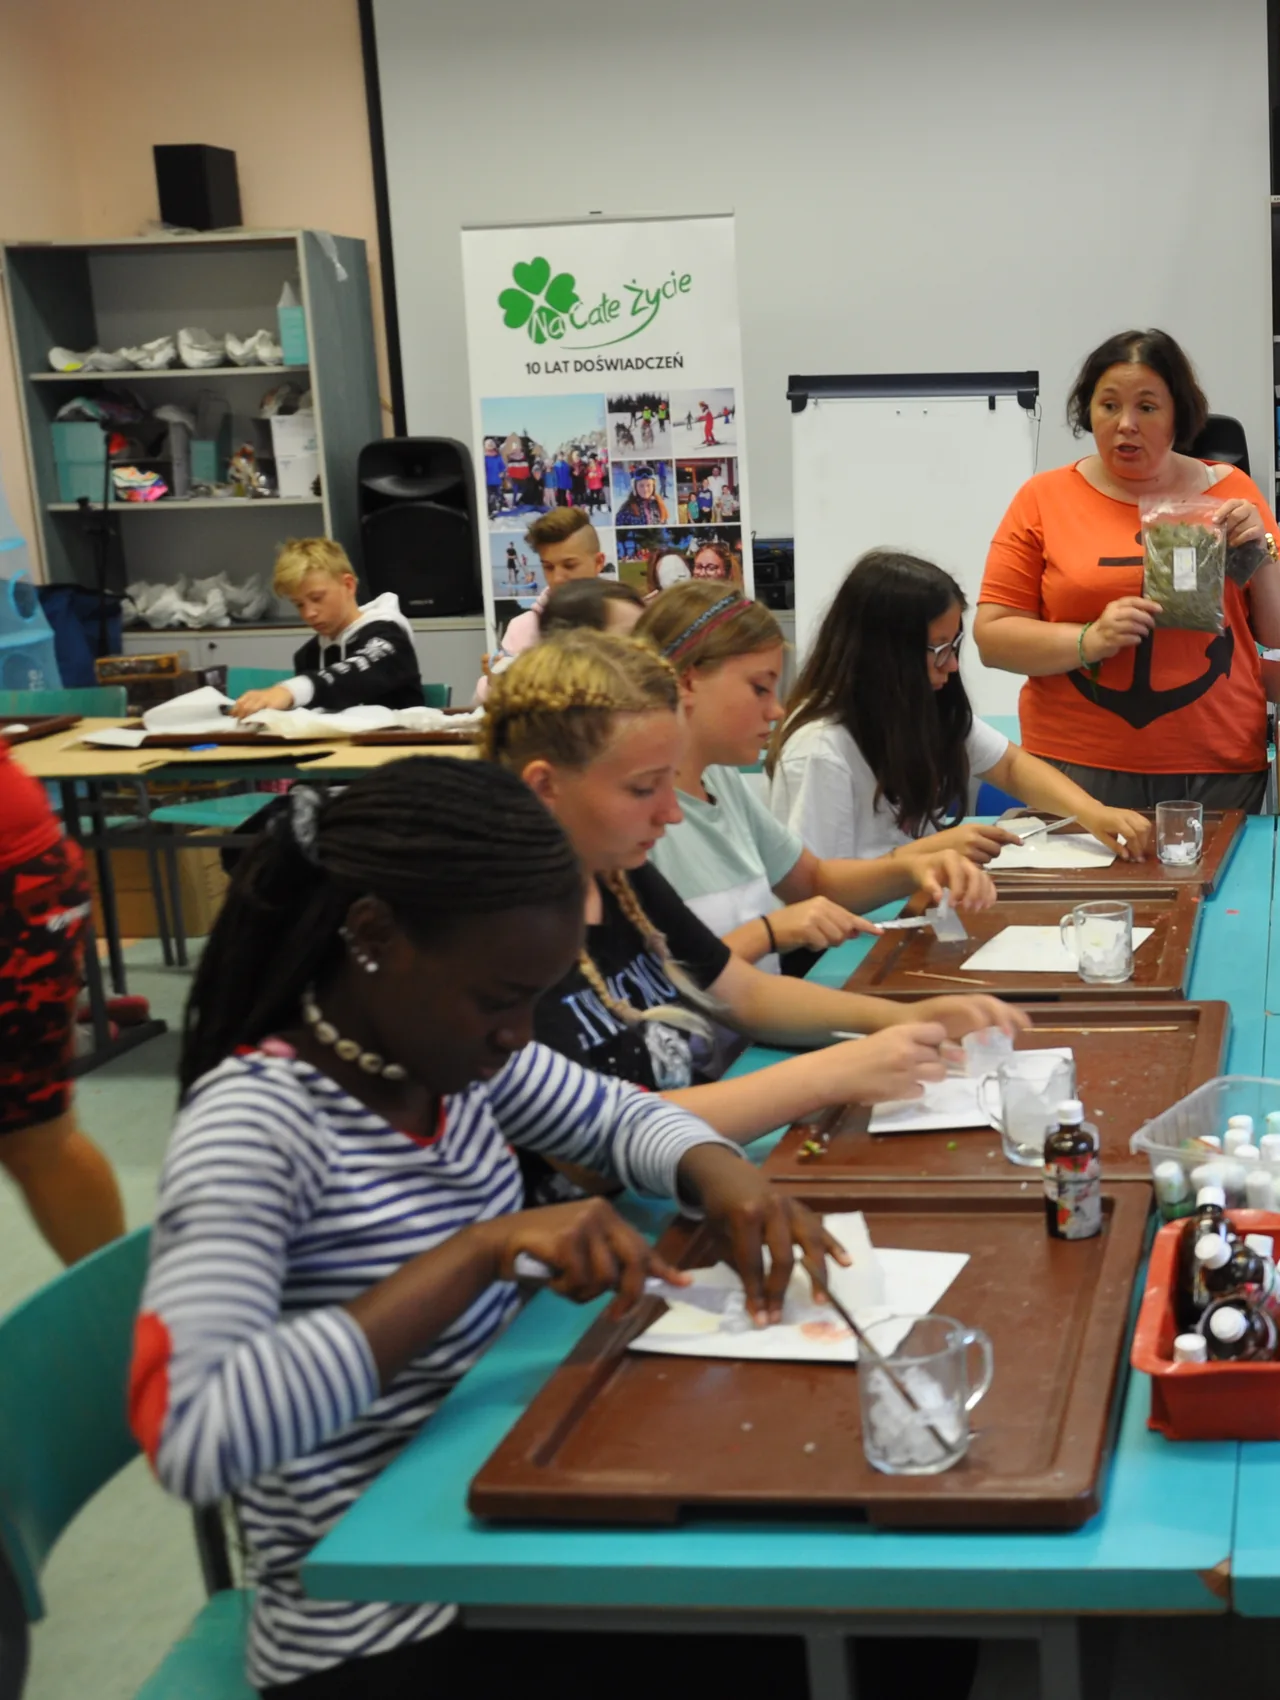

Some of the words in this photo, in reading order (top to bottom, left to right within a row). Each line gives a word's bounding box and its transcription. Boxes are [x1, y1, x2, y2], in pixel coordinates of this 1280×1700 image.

[531, 311, 566, 341] Na
[525, 361, 541, 375] 10
[544, 360, 570, 374] LAT
[574, 351, 684, 373] DOŚWIADCZEŃ
